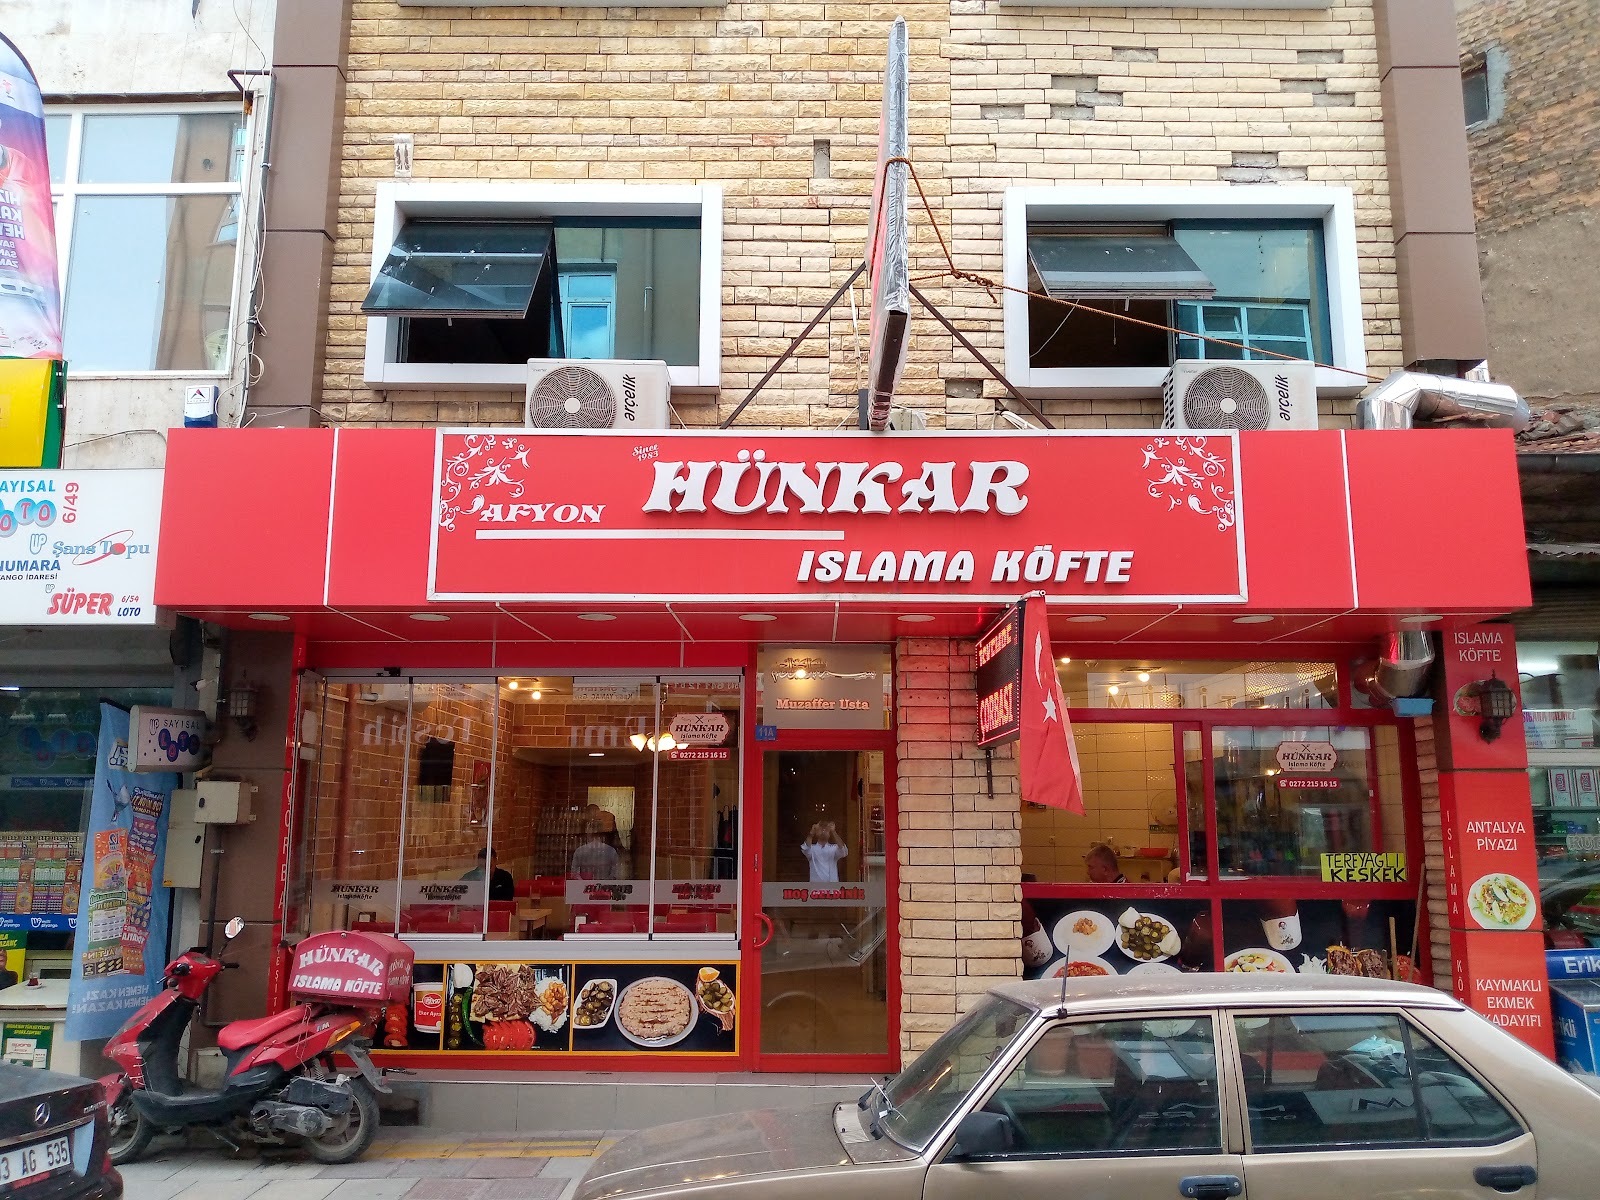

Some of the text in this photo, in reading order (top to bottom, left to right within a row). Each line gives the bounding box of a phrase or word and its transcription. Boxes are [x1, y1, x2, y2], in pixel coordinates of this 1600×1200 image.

[623, 373, 638, 421] arçelik
[1275, 374, 1293, 421] arçelik
[632, 444, 658, 457] Since
[637, 450, 659, 462] 1983
[641, 449, 1030, 516] HÜNKAR
[62, 482, 79, 523] 6/49
[480, 503, 606, 524] AFYON
[52, 540, 96, 558] Şans
[797, 544, 1135, 583] ISLAMA KÖFTE
[47, 587, 114, 616] SÜPER
[117, 607, 141, 617] LOTO
[1454, 632, 1504, 644] ISLAMA
[1459, 648, 1502, 661] KÖFTE
[776, 698, 870, 711] Muzaffer Usta
[675, 723, 724, 732] HÜNKAR
[759, 727, 775, 737] 11A
[1282, 752, 1332, 761] HÜNKAR
[1289, 780, 1305, 788] 0272
[1307, 780, 1319, 788] 215
[1329, 780, 1337, 788] 15
[1466, 821, 1526, 834] ANTALYA
[1446, 810, 1458, 914] ISLAMA
[1330, 867, 1407, 882] KESKEK
[783, 889, 808, 902] HOŞ
[299, 944, 384, 976] HÜNKAR
[292, 974, 383, 995] ISLAMA KÖFTE
[1476, 979, 1542, 992] KAYMAKLI
[1487, 997, 1534, 1009] EKMEK
[22, 1149, 36, 1176] AG
[46, 1140, 68, 1166] 535
